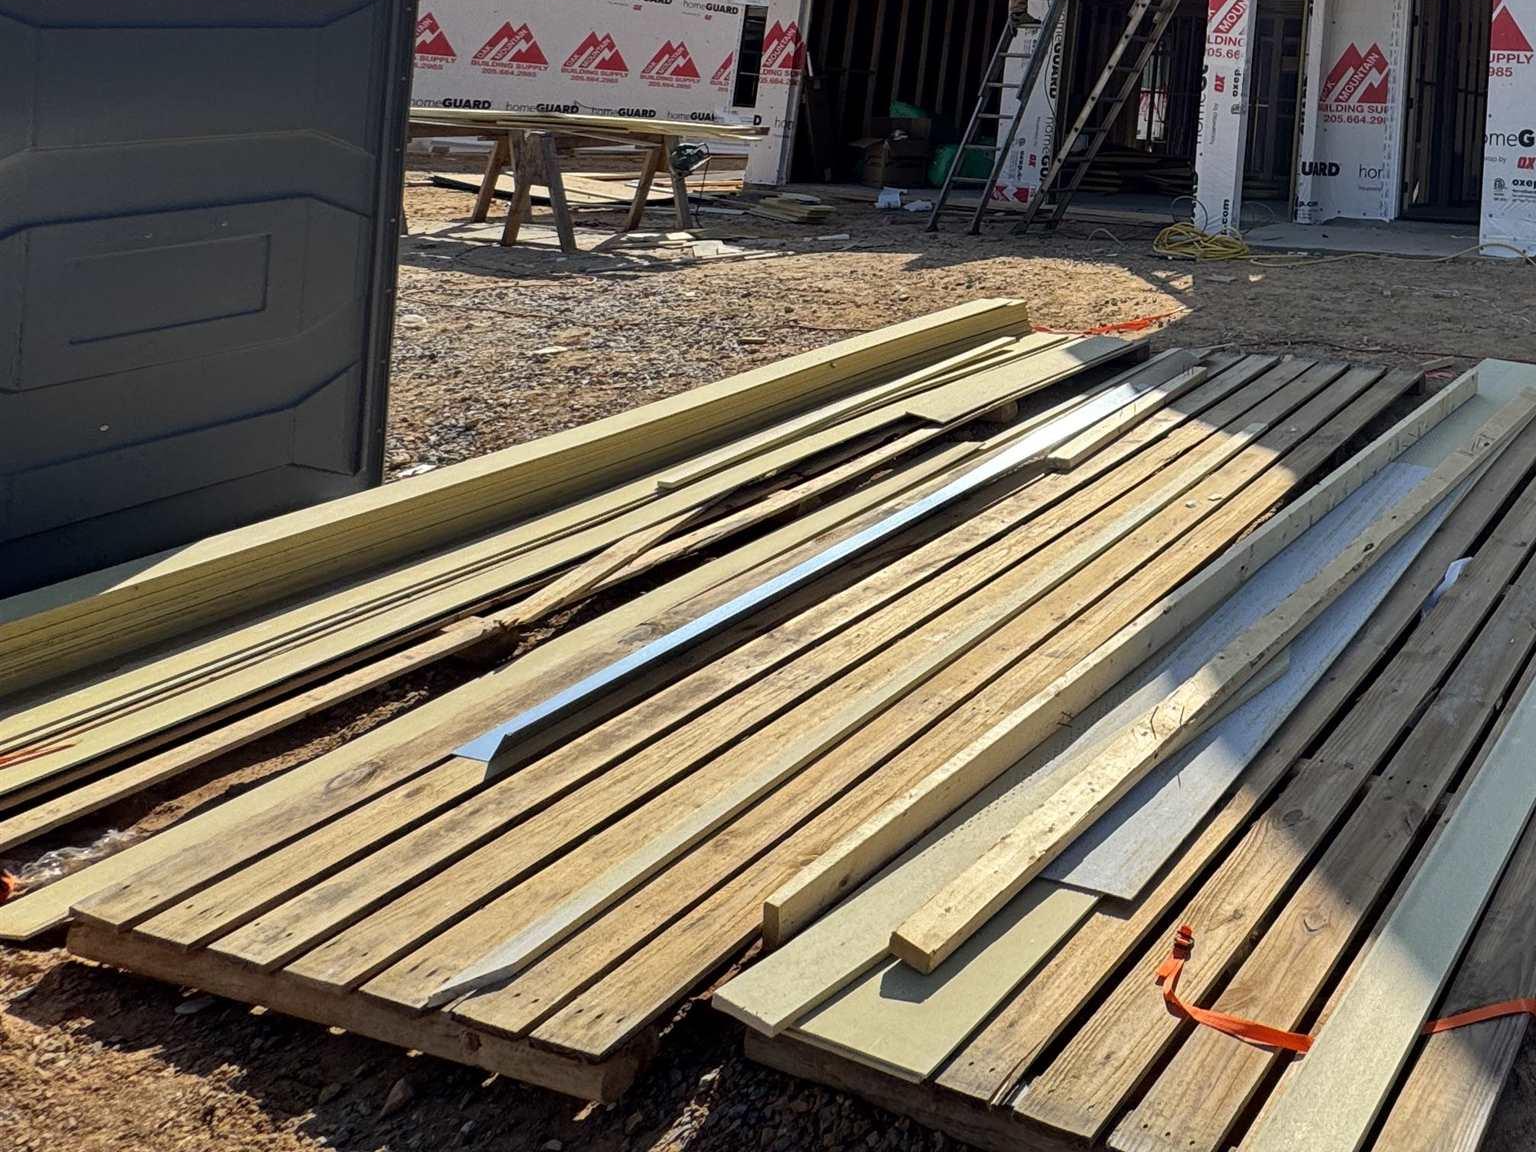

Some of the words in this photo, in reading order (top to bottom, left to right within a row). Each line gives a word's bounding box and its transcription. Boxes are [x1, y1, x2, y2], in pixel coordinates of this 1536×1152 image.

[683, 0, 739, 15] homeGUARD
[1339, 52, 1379, 101] MOUNTAIN
[506, 102, 579, 114] homeGUARD
[591, 106, 656, 118] homeGUARD
[1517, 156, 1536, 169] OX
